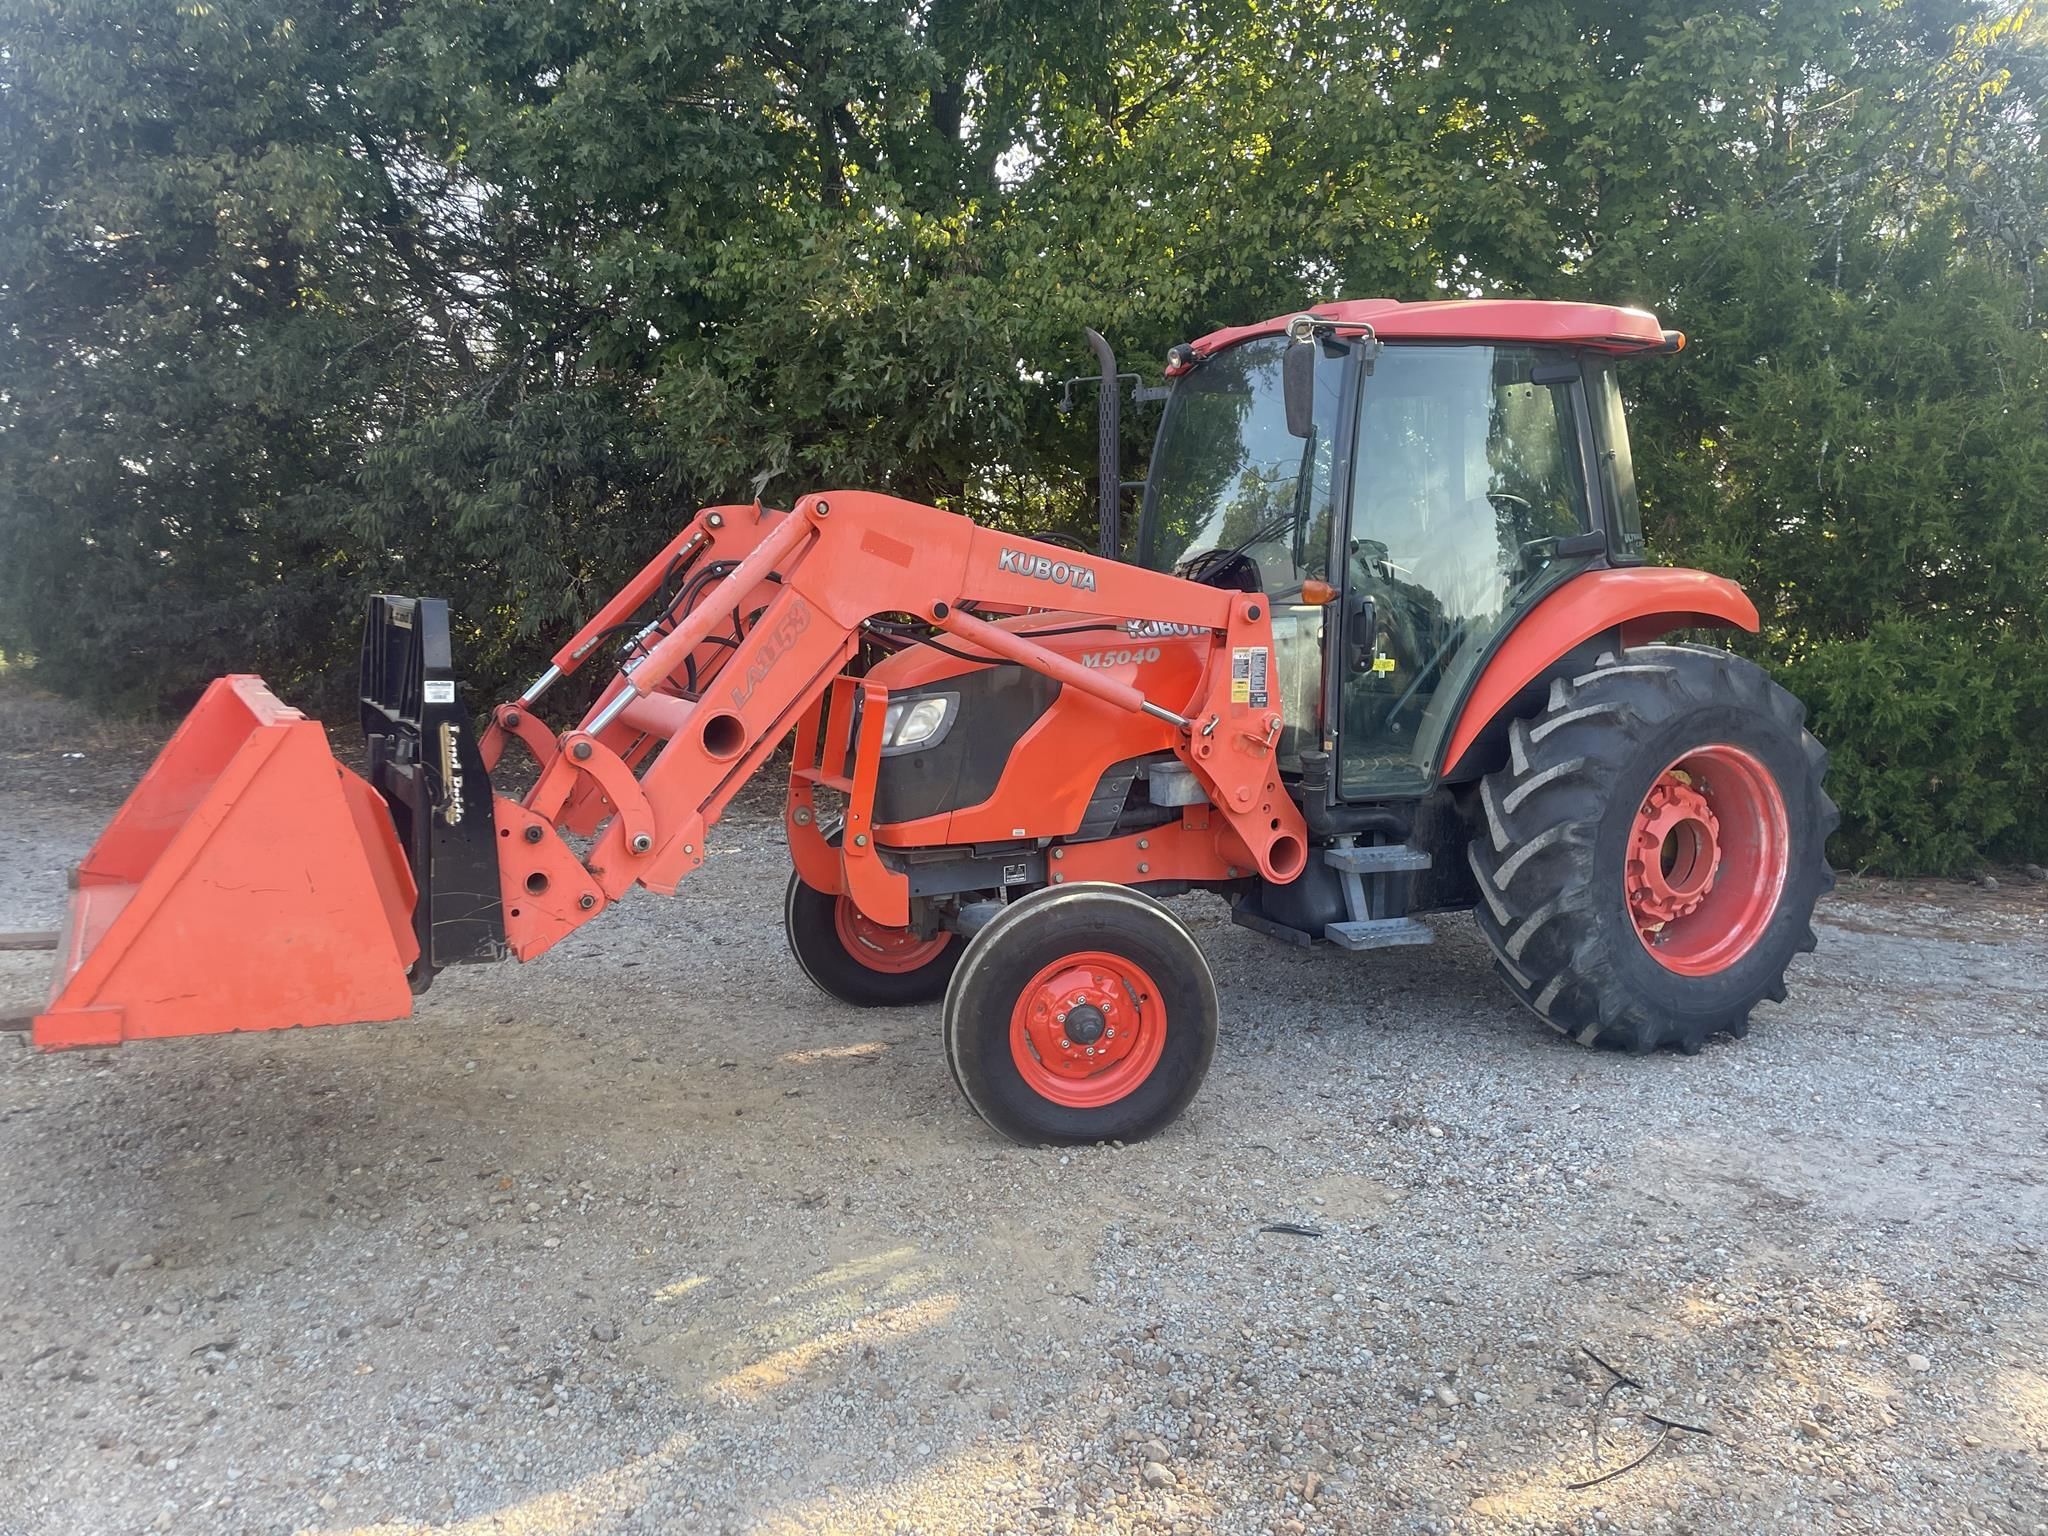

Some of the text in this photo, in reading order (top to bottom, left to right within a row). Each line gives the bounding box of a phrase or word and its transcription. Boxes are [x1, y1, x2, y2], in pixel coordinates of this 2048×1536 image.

[999, 548, 1096, 592] KUBOTA
[1081, 647, 1161, 668] M5040
[448, 725, 465, 823] Land Pride
